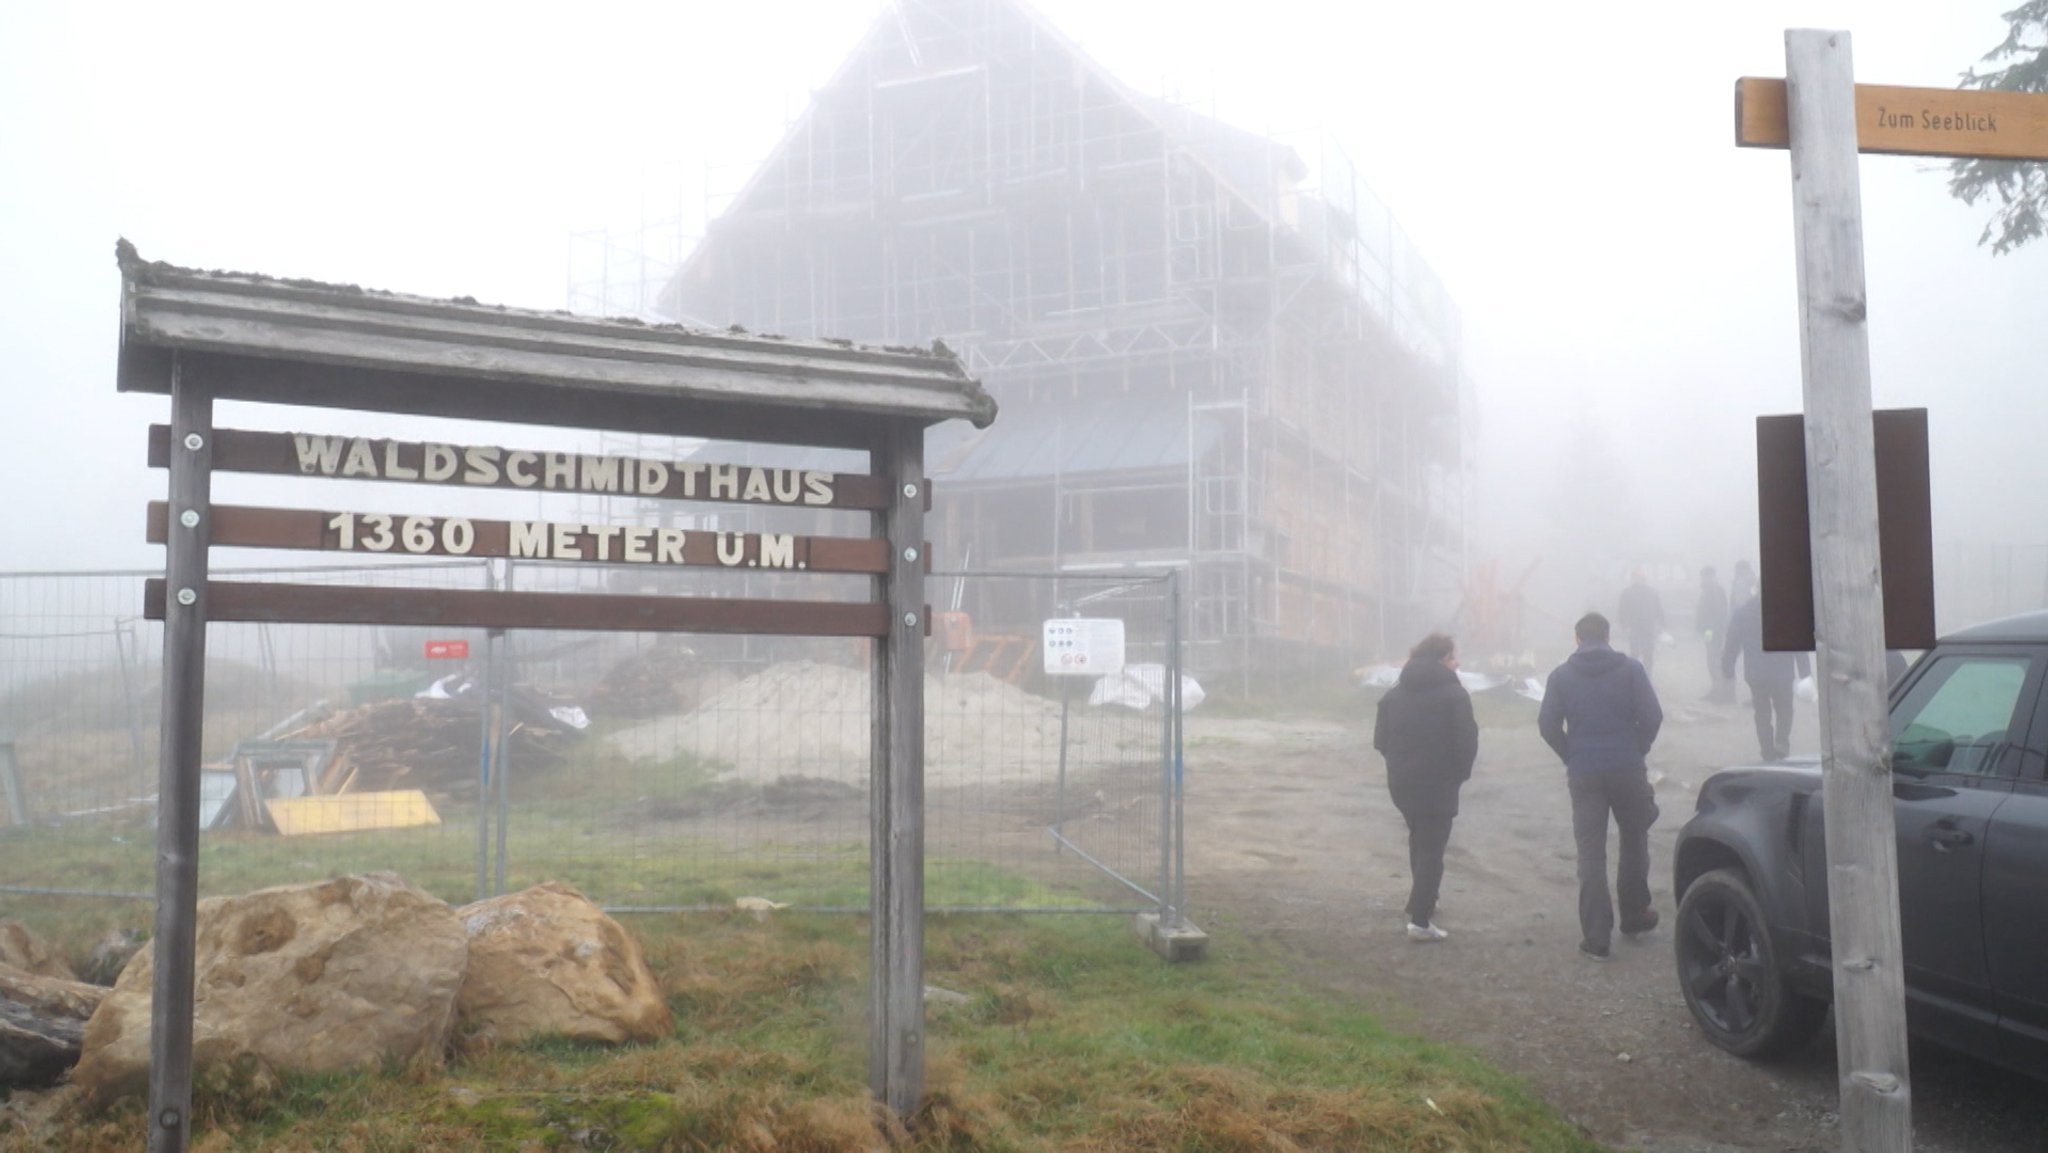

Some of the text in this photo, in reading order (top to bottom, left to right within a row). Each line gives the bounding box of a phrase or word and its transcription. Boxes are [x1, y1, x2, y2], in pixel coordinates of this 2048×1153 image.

[1877, 106, 1997, 132] Zum Seeblick
[294, 433, 834, 504] WALDSCHMIDTHAUS
[328, 512, 475, 554] 1360
[509, 521, 686, 564] METER
